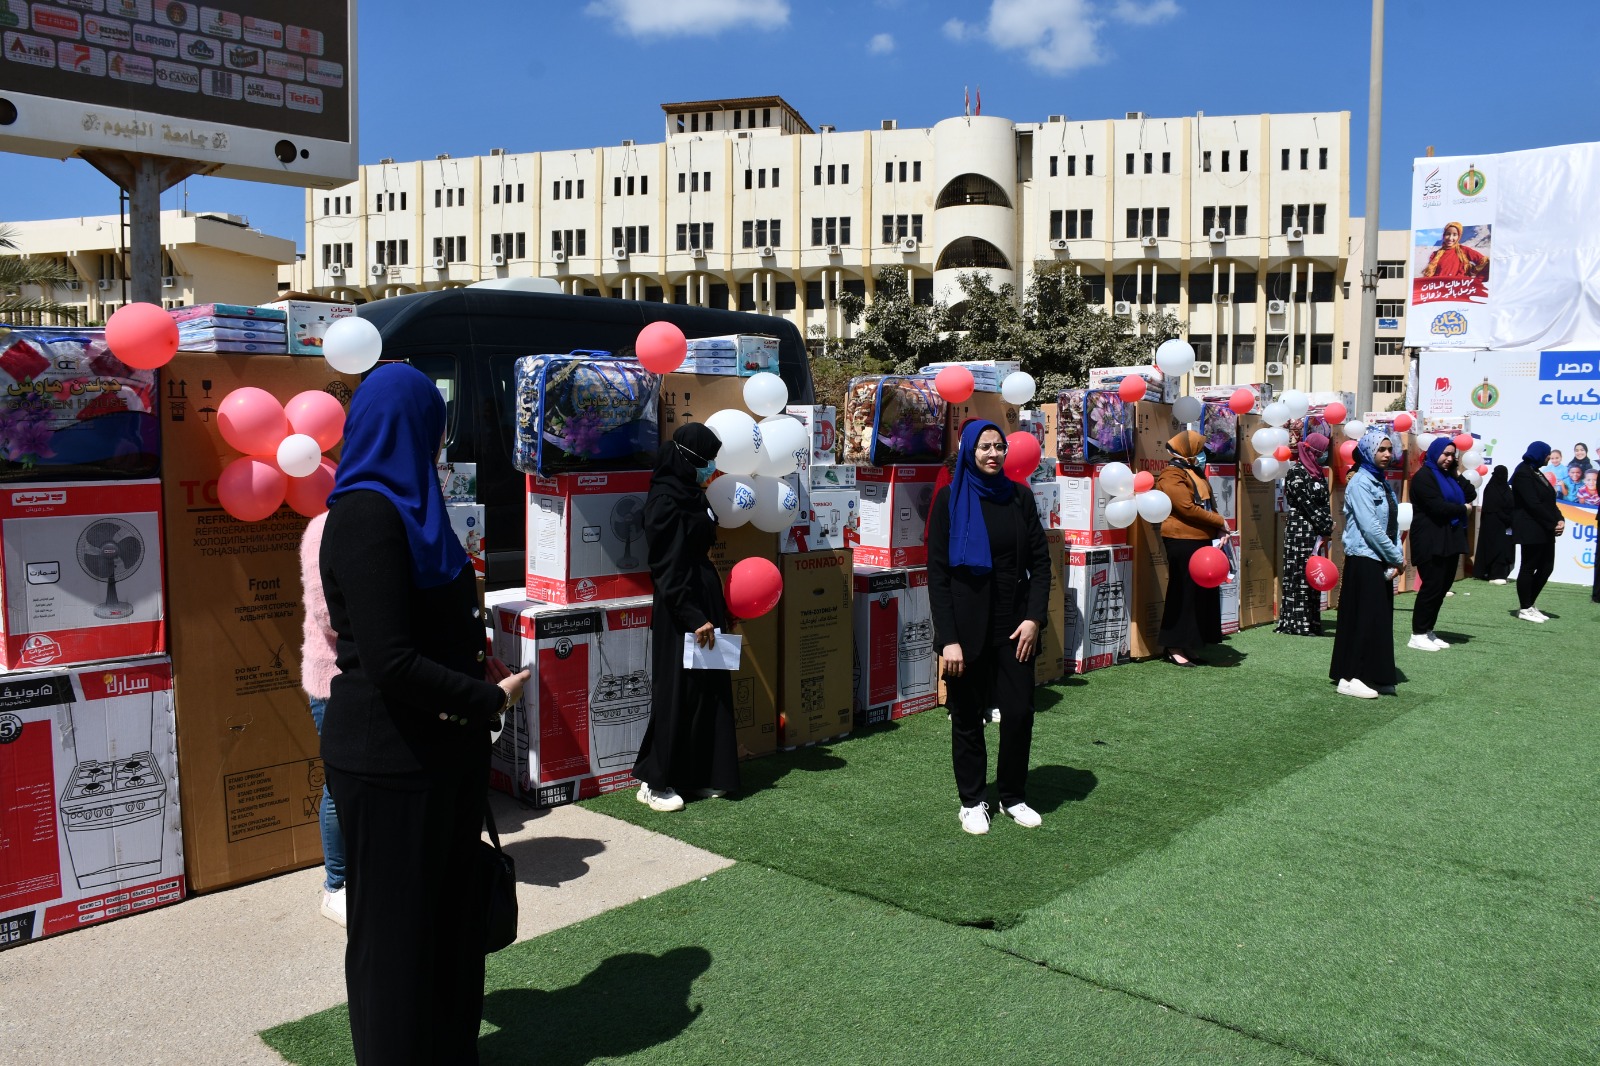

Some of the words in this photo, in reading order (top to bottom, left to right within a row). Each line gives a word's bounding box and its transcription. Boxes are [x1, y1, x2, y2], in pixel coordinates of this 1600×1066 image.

[134, 33, 177, 48] ELARABY
[169, 72, 198, 84] CANON
[247, 84, 265, 92] ALEX
[247, 90, 281, 101] APPARELS
[289, 92, 321, 106] Tefal
[103, 119, 152, 139] الفيوم
[161, 124, 207, 149] جامعة
[1421, 280, 1444, 291] المسافات
[1445, 280, 1461, 289] طالت
[1461, 278, 1475, 287] مهما
[1457, 286, 1477, 295] بنوصل
[1435, 311, 1465, 326] دكان
[1554, 363, 1594, 378] مصر
[69, 377, 122, 395] جولدن
[7, 399, 73, 410] GOLDEN
[77, 398, 128, 410] HOUSE
[15, 493, 50, 504] فريش
[795, 555, 845, 571] TORNADO
[249, 577, 280, 590] Front
[254, 592, 277, 602] Avant
[621, 612, 646, 629] سبارك
[560, 644, 568, 654] 5
[246, 665, 261, 673] NOT
[106, 674, 149, 695] سبارك
[0, 686, 40, 700] يونيڤ
[0, 722, 13, 738] 5
[244, 771, 265, 781] UPRIGHT
